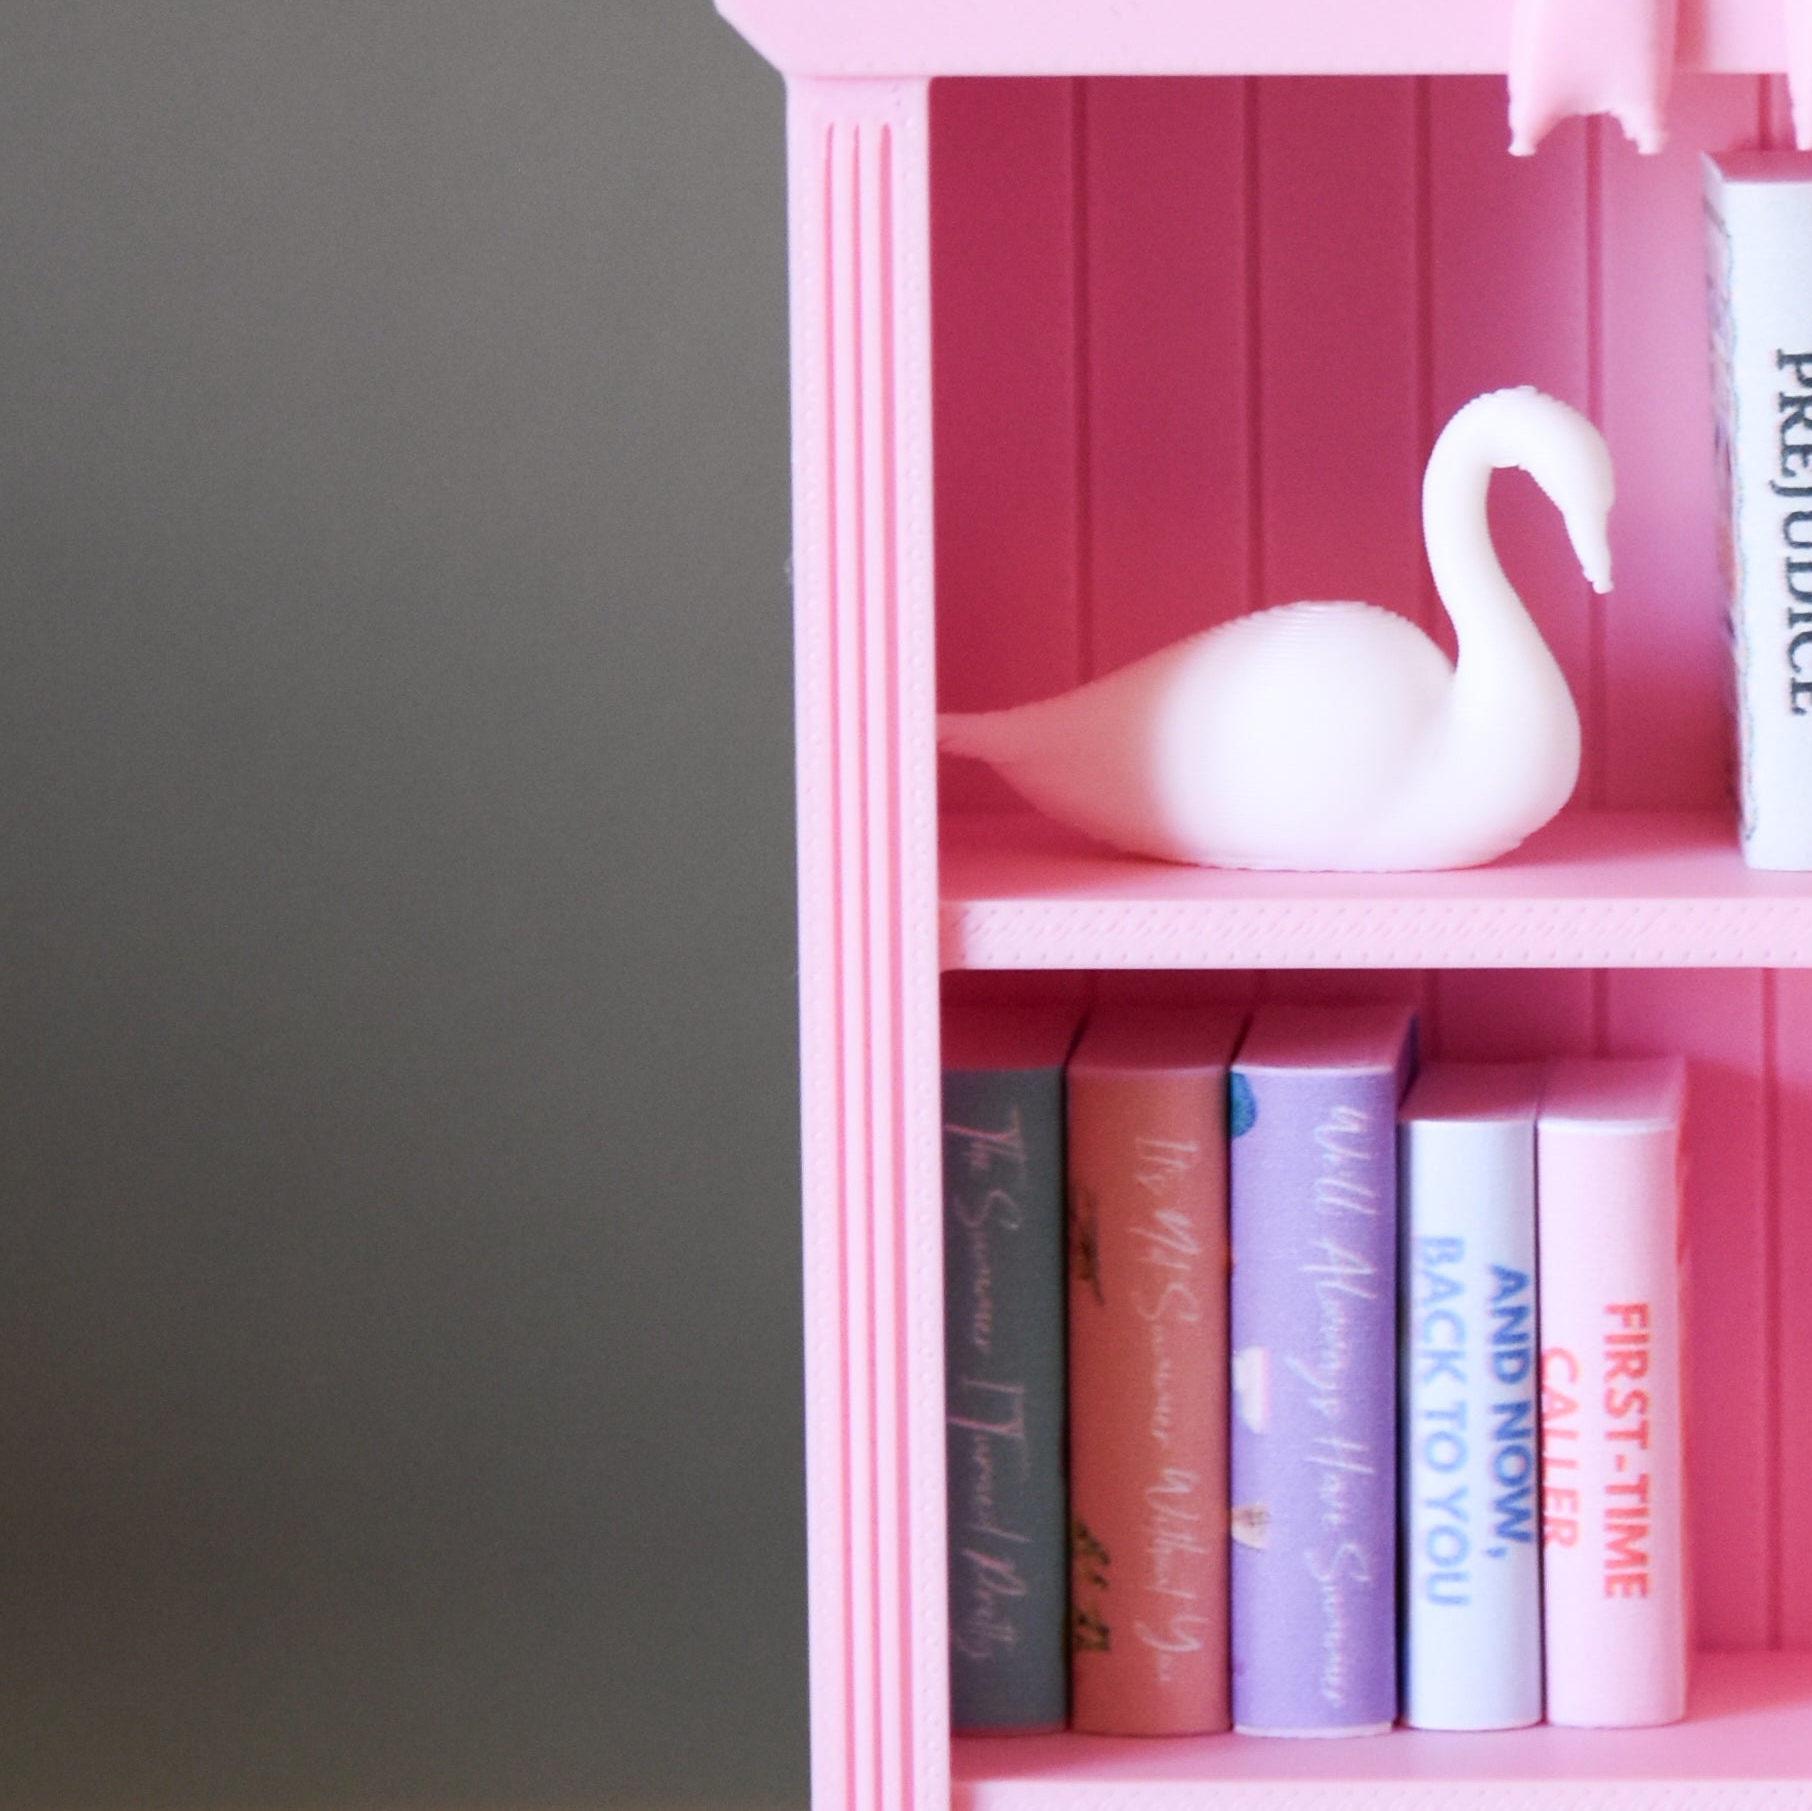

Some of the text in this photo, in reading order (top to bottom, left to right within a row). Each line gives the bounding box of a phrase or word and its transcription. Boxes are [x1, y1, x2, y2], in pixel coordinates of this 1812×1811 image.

[944, 1106, 1026, 1172] The
[1130, 1280, 1200, 1449] Summer
[1284, 1105, 1379, 1708] We'll Always Have Summer
[1418, 1234, 1470, 1607] BACK TO YOU
[1483, 1265, 1535, 1559] AND NOW,
[1543, 1346, 1579, 1549] CALLER
[1602, 1301, 1650, 1599] FIRST-TIME
